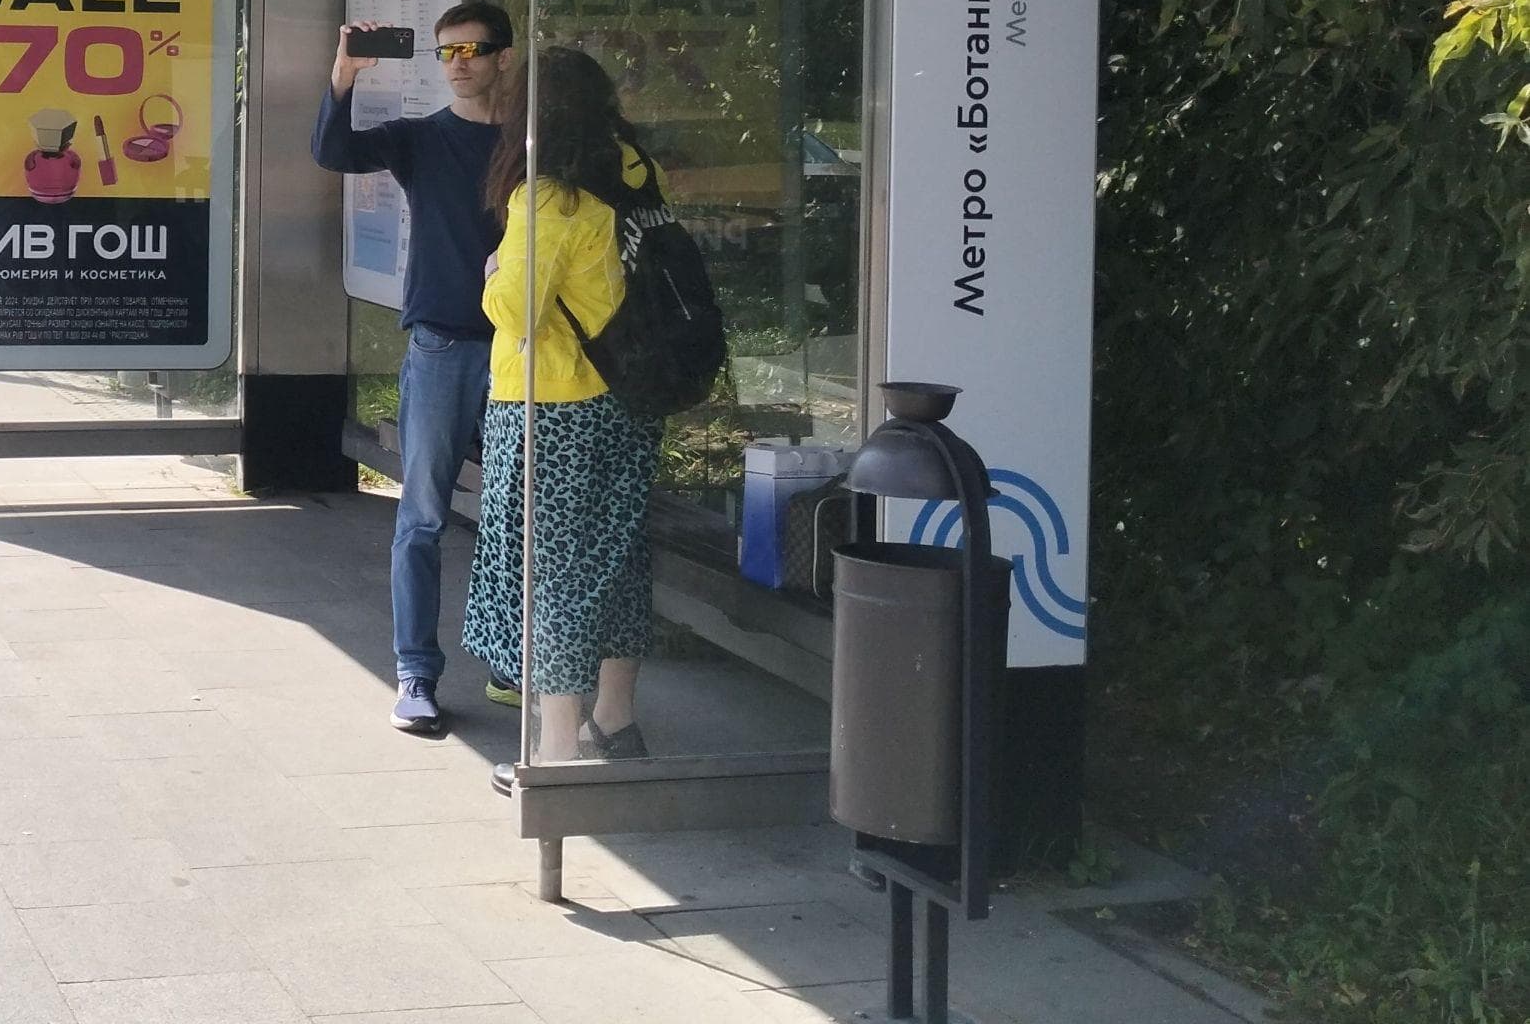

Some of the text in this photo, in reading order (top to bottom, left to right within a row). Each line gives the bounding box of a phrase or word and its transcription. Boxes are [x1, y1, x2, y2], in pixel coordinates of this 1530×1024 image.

[67, 225, 167, 261] ГОШ
[953, 169, 993, 316] Метро
[64, 269, 73, 280] И
[80, 269, 167, 281] КОСМЕТИКА
